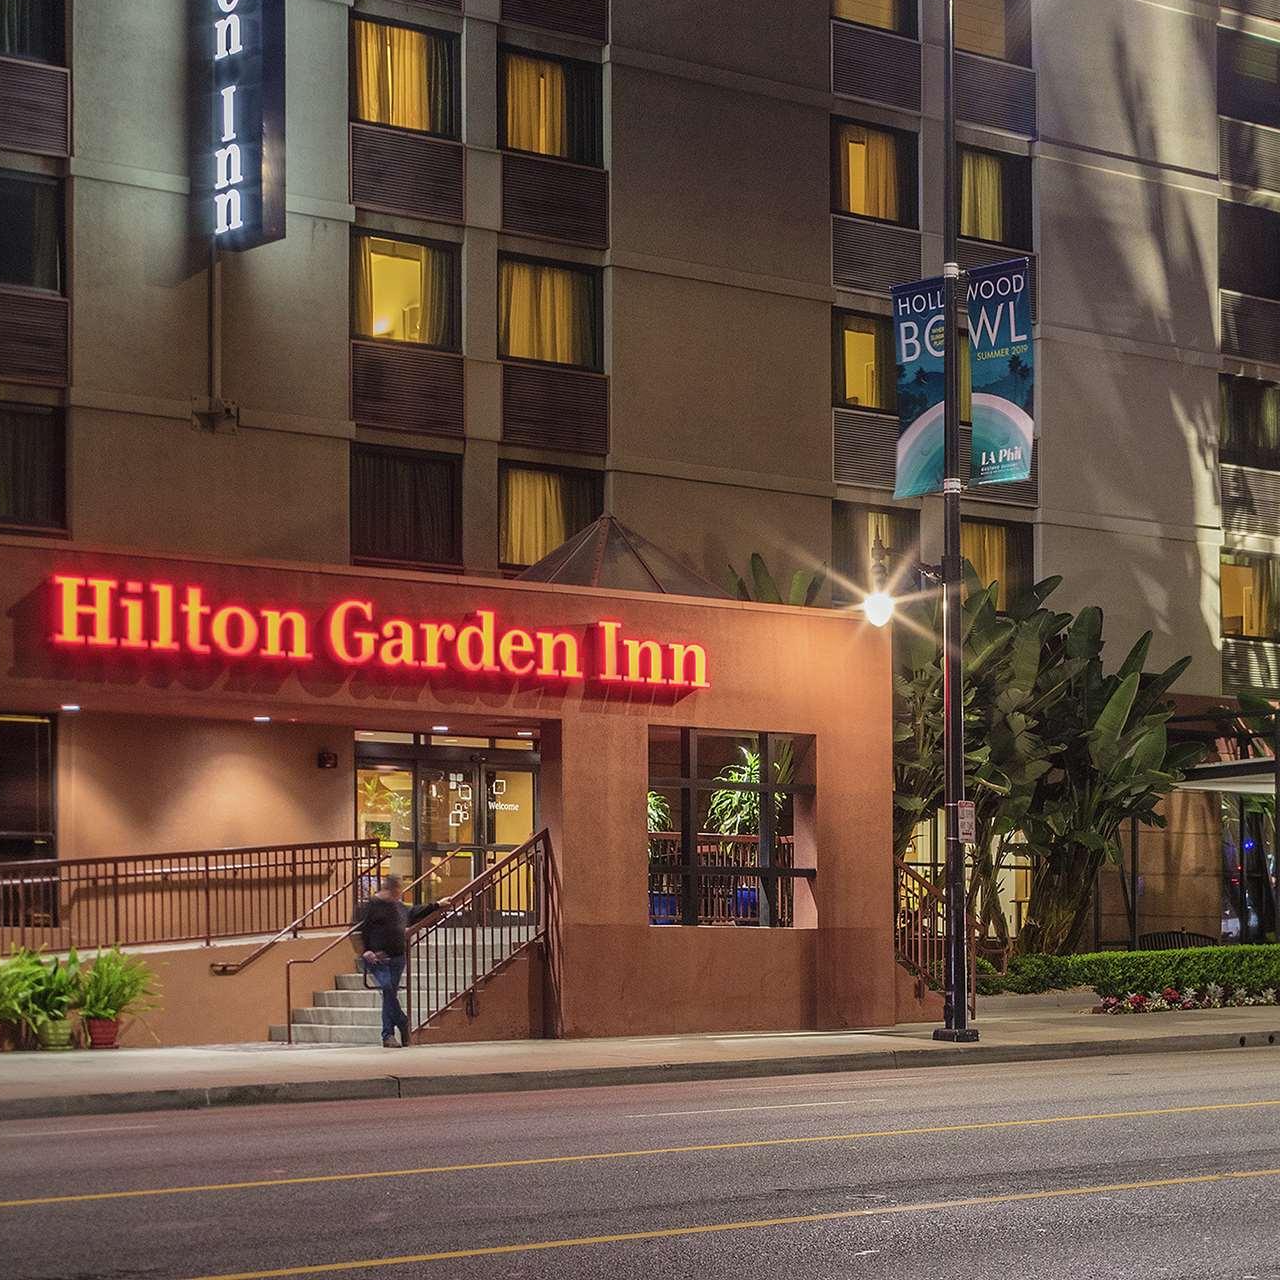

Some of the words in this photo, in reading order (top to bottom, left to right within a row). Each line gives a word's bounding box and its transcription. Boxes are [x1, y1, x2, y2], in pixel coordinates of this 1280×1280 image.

[214, 85, 244, 235] Inn
[898, 274, 1024, 316] HOLLWOOD
[976, 347, 1009, 361] SUMMER
[981, 451, 996, 465] LA
[999, 446, 1022, 463] Phil
[52, 575, 314, 660] Hilton
[328, 600, 584, 679] Garden
[598, 621, 711, 688] Inn
[488, 801, 520, 811] Welcome
